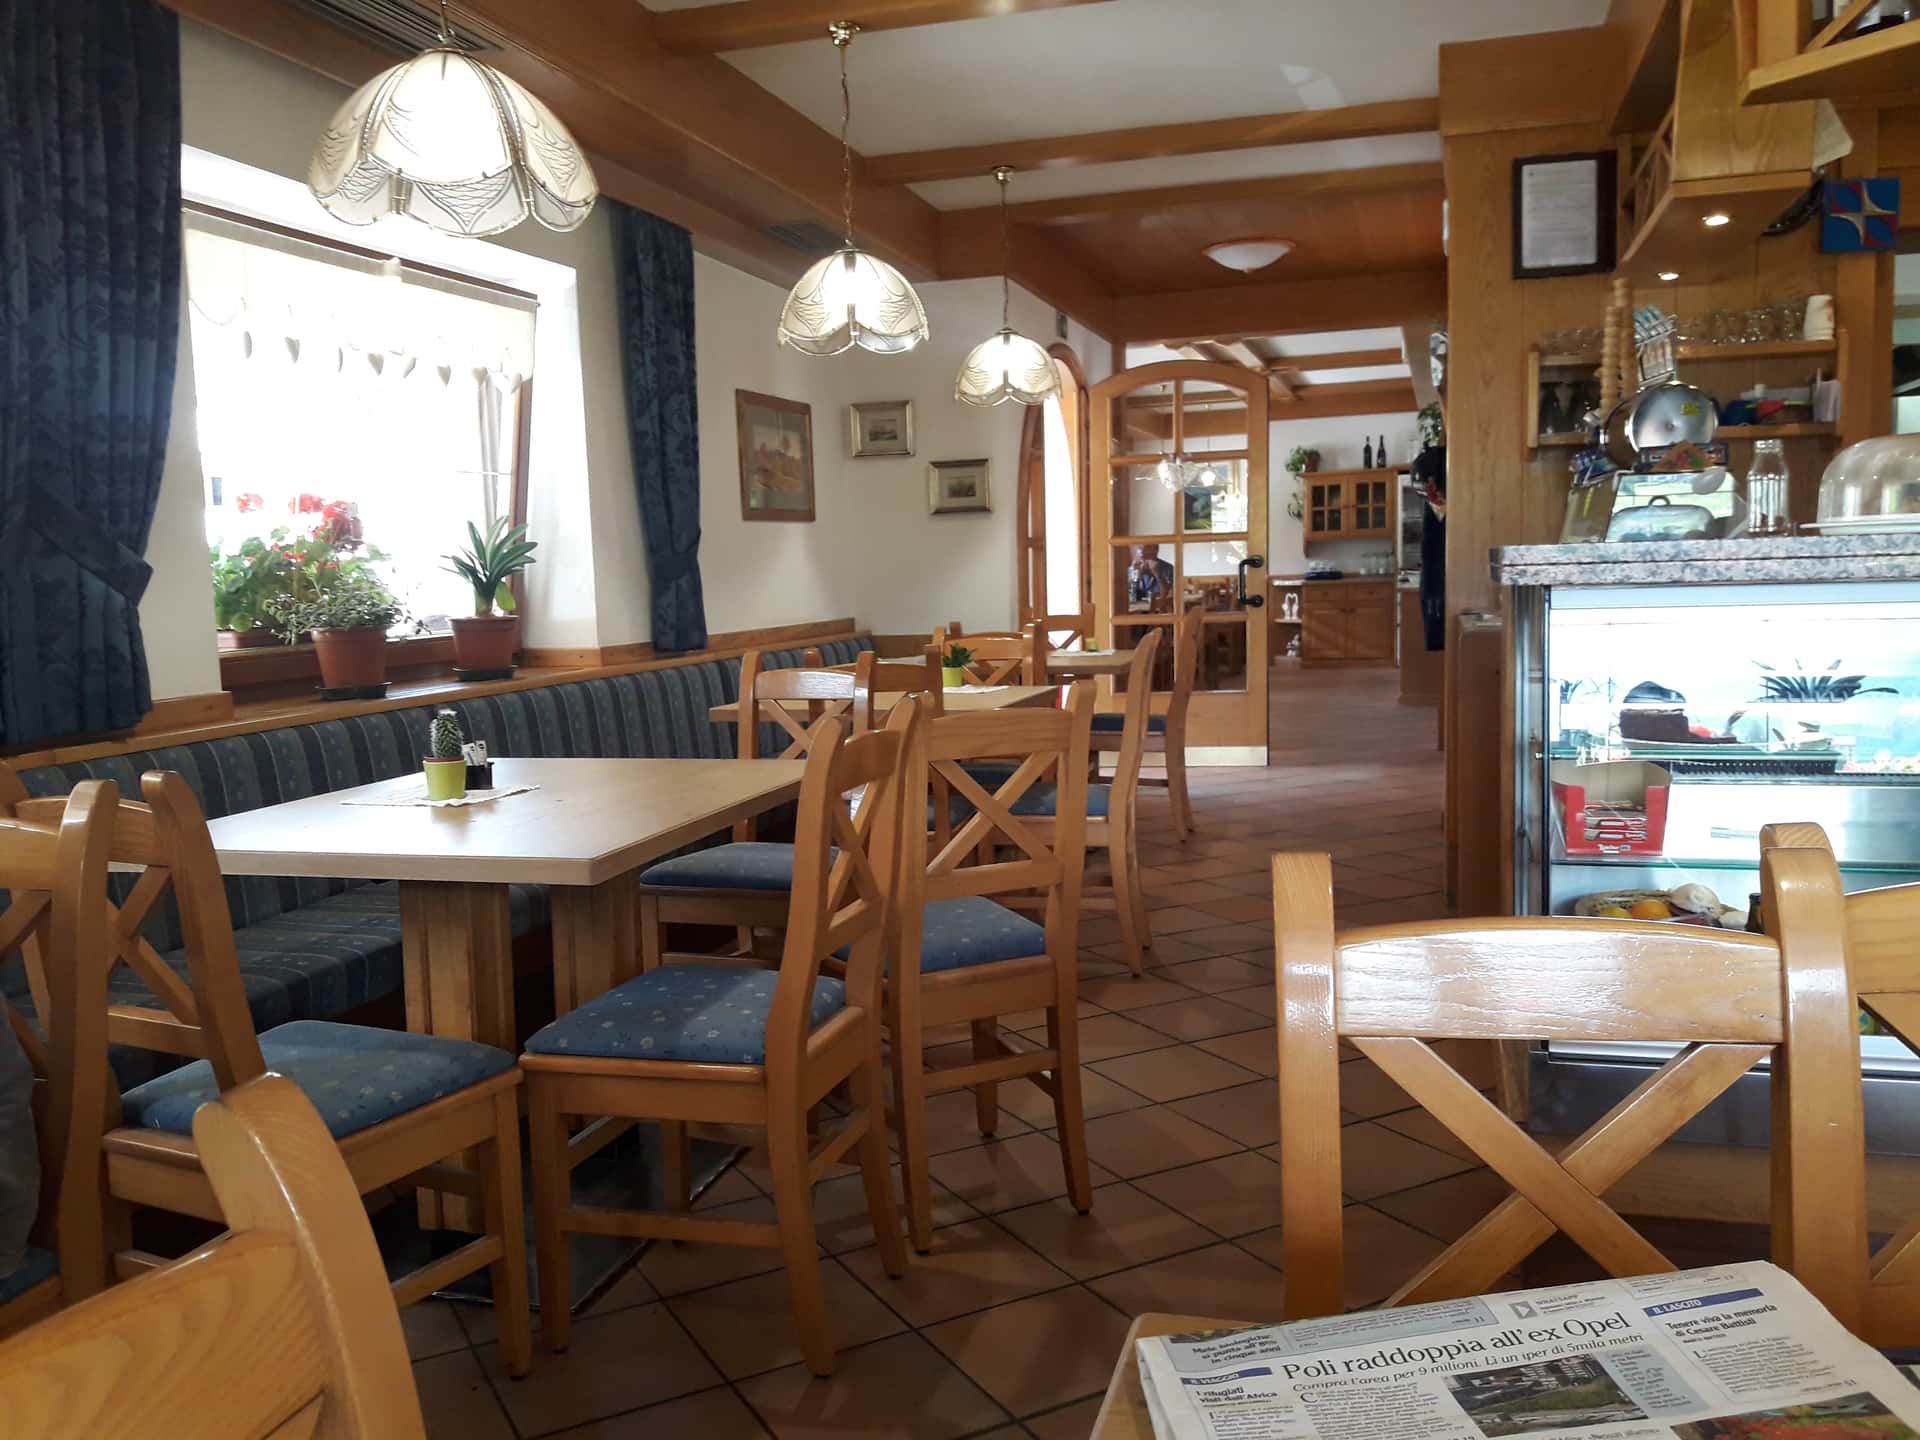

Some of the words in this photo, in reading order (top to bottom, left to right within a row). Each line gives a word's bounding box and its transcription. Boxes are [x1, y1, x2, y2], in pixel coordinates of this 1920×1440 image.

[1652, 1305, 1662, 1314] IL
[1663, 1299, 1702, 1312] LASCITO
[1665, 1319, 1700, 1330] Tenere
[1701, 1315, 1722, 1325] viva
[1723, 1312, 1733, 1320] la
[1734, 1304, 1778, 1317] memoria
[1675, 1329, 1685, 1337] di
[1686, 1324, 1720, 1336] Cesare
[1720, 1318, 1757, 1330] Battisti
[1282, 1359, 1339, 1380] Poli
[1343, 1338, 1486, 1373] raddoppia
[1563, 1311, 1633, 1338] Opel
[1293, 1378, 1347, 1392] Compra
[1350, 1374, 1390, 1385] l'area
[1393, 1370, 1416, 1383] per
[1418, 1366, 1428, 1376] 9
[1501, 1354, 1519, 1364] un
[1521, 1349, 1549, 1363] iper
[1551, 1343, 1565, 1354] di
[1567, 1339, 1607, 1352] 5mila
[1608, 1333, 1645, 1345] metri
